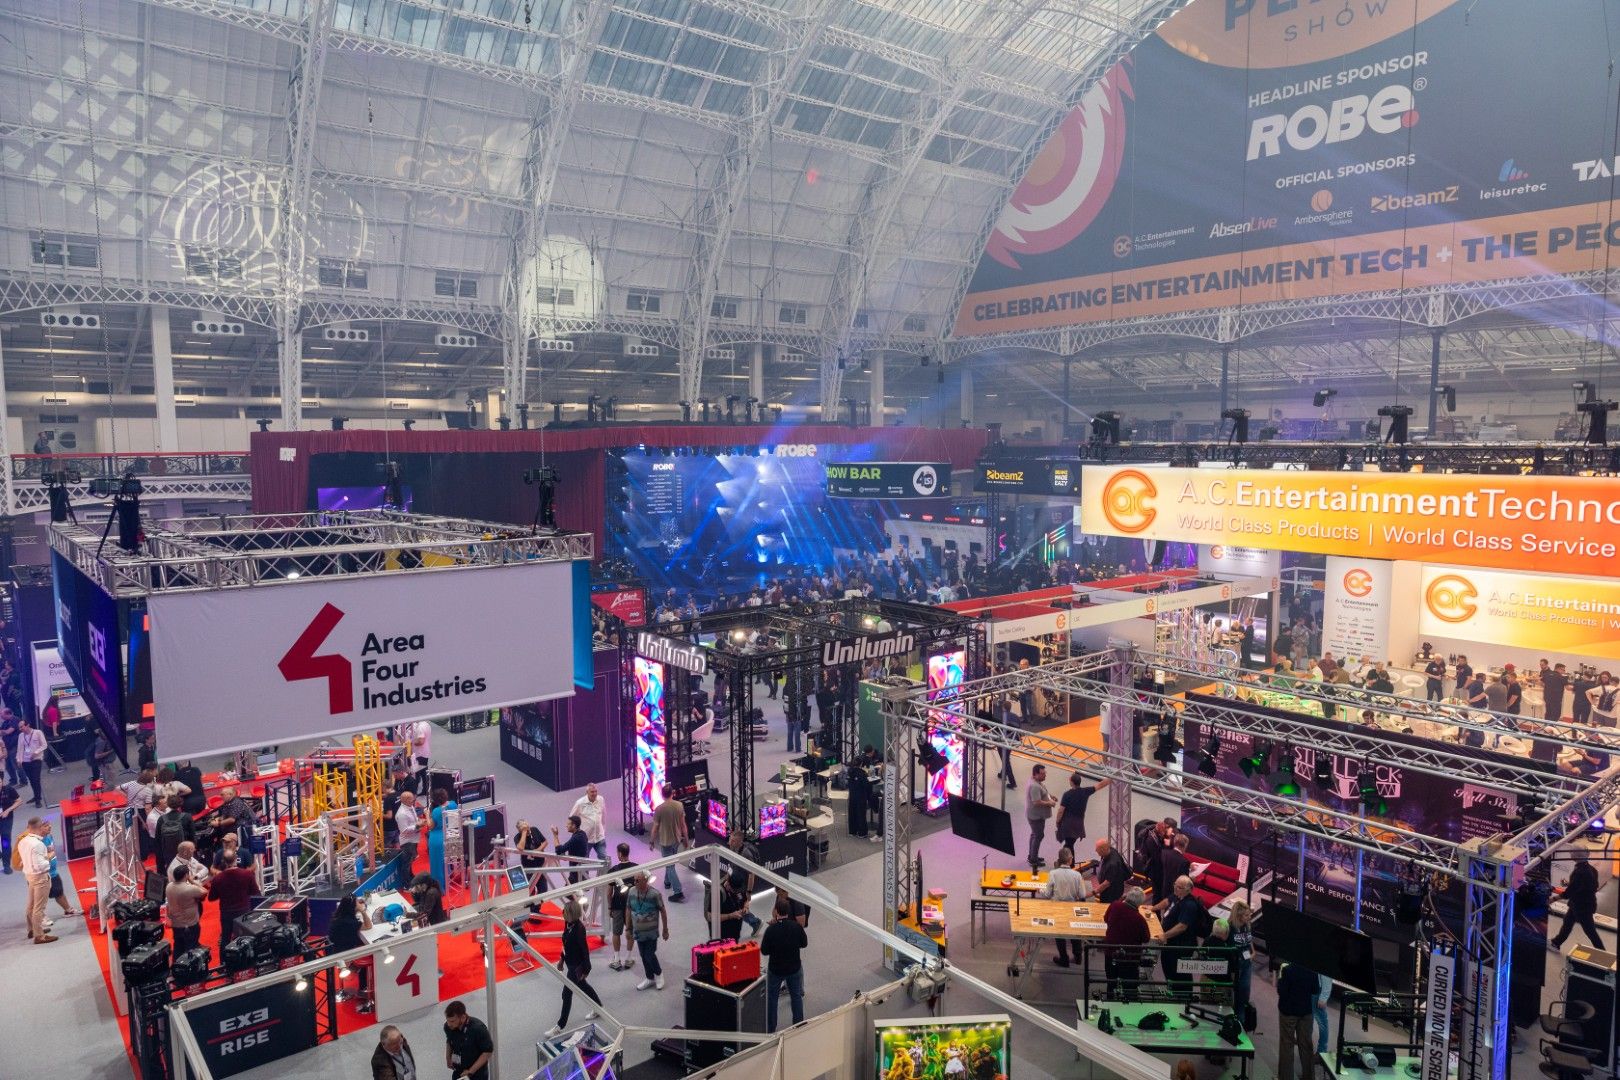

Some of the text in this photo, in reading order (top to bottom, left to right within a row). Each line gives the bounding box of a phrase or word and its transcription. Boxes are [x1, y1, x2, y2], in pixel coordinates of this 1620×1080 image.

[1284, 0, 1388, 42] SHOW
[1248, 50, 1428, 108] HEADLINE SPONSOR
[1275, 153, 1416, 189] OFFICIAL SPONSORS
[1388, 186, 1459, 211] beamZ
[1480, 183, 1547, 200] leisuretec
[1209, 217, 1277, 238] AbsenLive
[1294, 208, 1353, 226] Ambersphere
[974, 286, 1107, 322] CELEBRATING
[1111, 257, 1335, 304] ENTERTAINMENT
[1340, 244, 1428, 276] TECH
[1461, 230, 1538, 263] THE
[849, 467, 881, 480] BAR
[994, 470, 1023, 481] beamZ
[1178, 513, 1223, 531] World
[1228, 514, 1273, 535] Class
[1279, 519, 1360, 541] Products
[1383, 525, 1445, 546] World
[1453, 529, 1513, 551] Class
[1520, 533, 1616, 558] Service
[1488, 608, 1597, 627] World Class Products
[361, 633, 425, 656] Area
[638, 631, 706, 674] Unilumin
[823, 631, 914, 666] Unilumin
[362, 660, 419, 683] Four
[363, 675, 487, 710] Industries
[886, 769, 894, 832] ALUMINIUM
[886, 833, 894, 891] PLATFORMS
[885, 892, 893, 906] BY
[1181, 962, 1225, 973] Hall Stage
[1433, 965, 1449, 1010] CURVED
[220, 1029, 270, 1056] RISE
[1430, 1010, 1447, 1048] MOVIE
